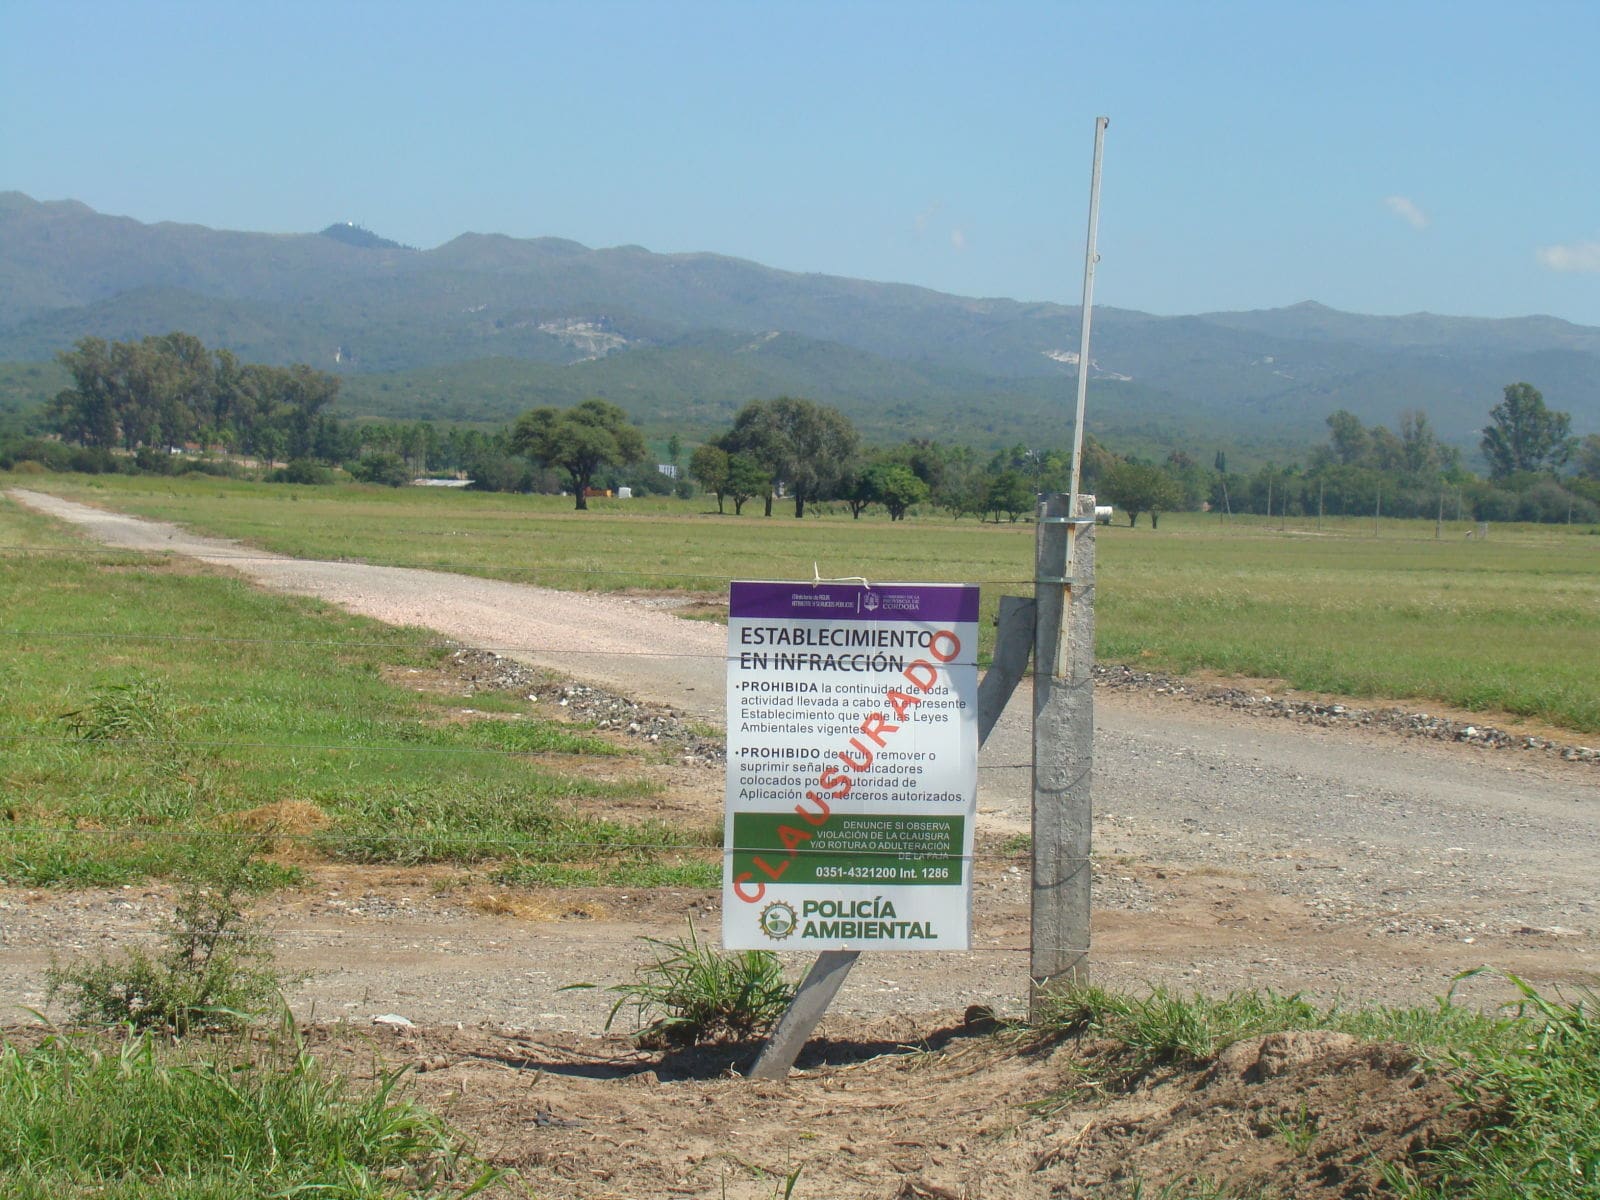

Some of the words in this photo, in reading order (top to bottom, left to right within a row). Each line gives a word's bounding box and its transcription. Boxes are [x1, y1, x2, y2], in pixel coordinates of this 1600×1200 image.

[741, 627, 932, 648] ESTABLECIMIENTO
[740, 652, 767, 670] EN
[774, 652, 903, 672] INFRACCIÓN
[742, 682, 818, 693] PROHIBIDA
[821, 683, 832, 693] la
[835, 684, 902, 695] continuidad
[905, 684, 920, 695] de
[741, 695, 794, 706] actividad
[797, 696, 839, 706] llevada
[842, 698, 849, 707] a
[852, 697, 880, 707] cabo
[884, 700, 898, 708] en
[914, 699, 966, 710] presente
[741, 708, 835, 720] Establecimiento
[838, 712, 860, 722] que
[893, 711, 910, 721] las
[913, 711, 949, 724] Leyes
[740, 722, 814, 733] Ambientales
[741, 747, 820, 759] PROHIBIDO
[876, 752, 926, 760] remover
[928, 752, 936, 760] o
[733, 629, 961, 904] CLAUSURADO
[740, 761, 790, 773] suprimir
[792, 762, 839, 773] señales
[842, 764, 850, 773] o
[853, 763, 923, 774] indicadores
[739, 775, 802, 786] colocados
[902, 777, 917, 788] de
[739, 788, 802, 800] Aplicación
[816, 791, 837, 802] por
[838, 791, 888, 800] terceros
[891, 791, 966, 802] autorizados.
[843, 821, 892, 830] DENUNCIE
[895, 822, 904, 830] SI
[906, 822, 950, 831] OBSERVA
[817, 830, 868, 839] VIOLACIÓN
[886, 832, 898, 840] LA
[900, 832, 950, 841] CLAUSURA
[810, 840, 825, 849] Y/O
[827, 841, 867, 850] ROTURA
[868, 841, 877, 850] O
[878, 841, 950, 851] ADULTERACIÓN
[816, 866, 897, 878] 0351-4321200
[900, 868, 917, 879] Int.
[921, 868, 949, 879] 1286
[803, 896, 897, 919] POLICÍA
[801, 920, 938, 939] AMBIENTAL
